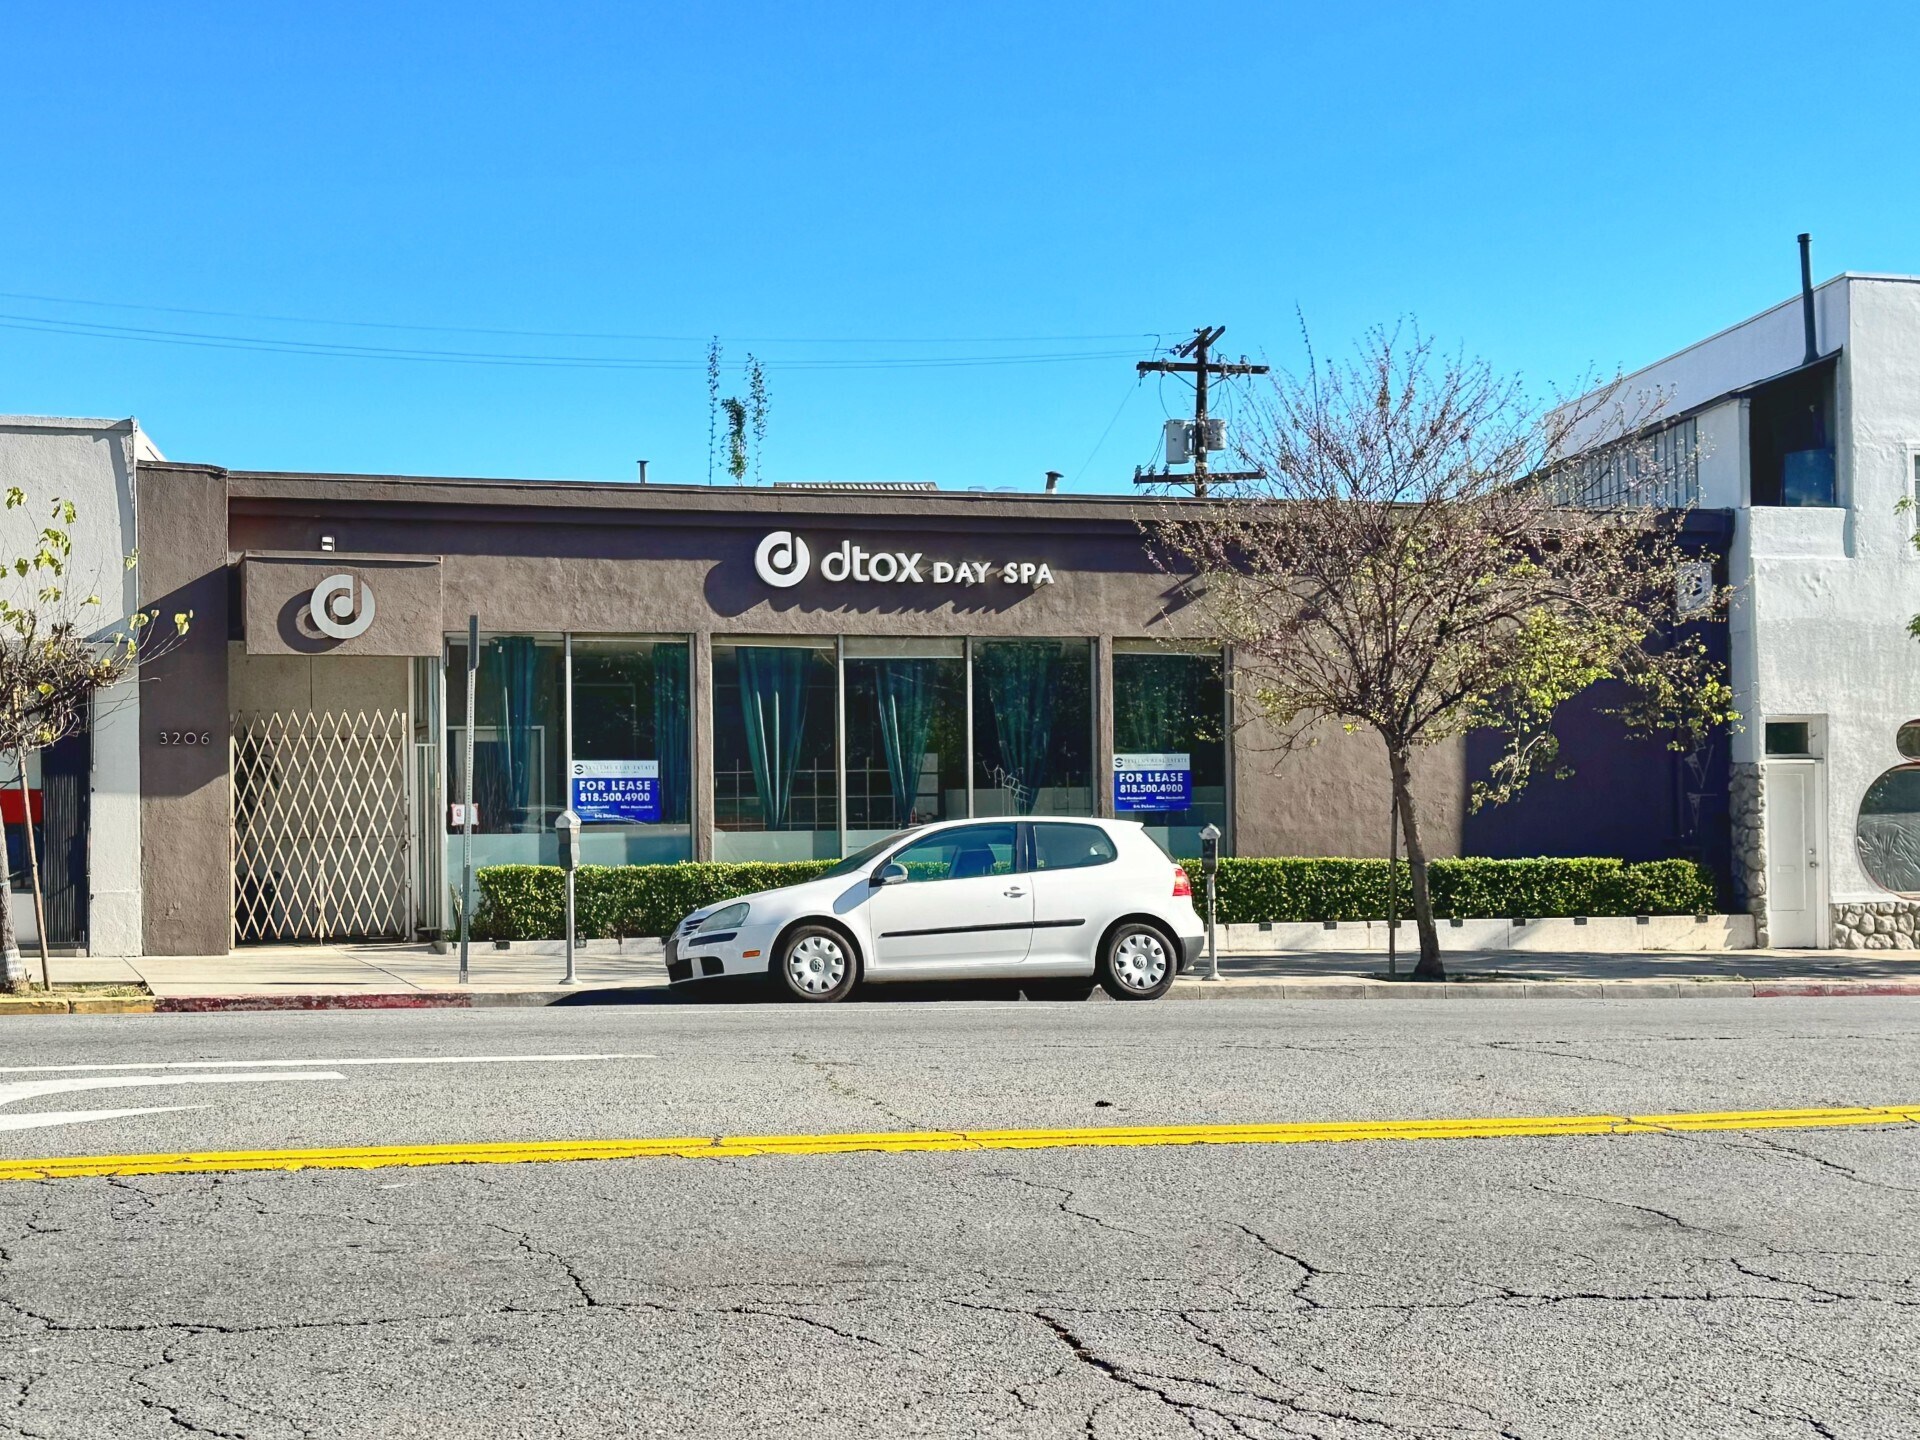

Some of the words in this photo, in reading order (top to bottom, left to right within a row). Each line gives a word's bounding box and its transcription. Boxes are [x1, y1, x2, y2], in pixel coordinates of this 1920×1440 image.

[820, 540, 924, 583] dtox
[933, 562, 992, 584] DAY
[1003, 563, 1055, 585] SPA
[159, 731, 211, 746] 3206
[1118, 772, 1143, 783] FOR
[1147, 772, 1184, 783] LEASE
[579, 780, 606, 791] FOR
[611, 780, 651, 791] LEASE
[1119, 783, 1183, 794] 818.500.4900
[579, 792, 650, 802] 818.500.4900
